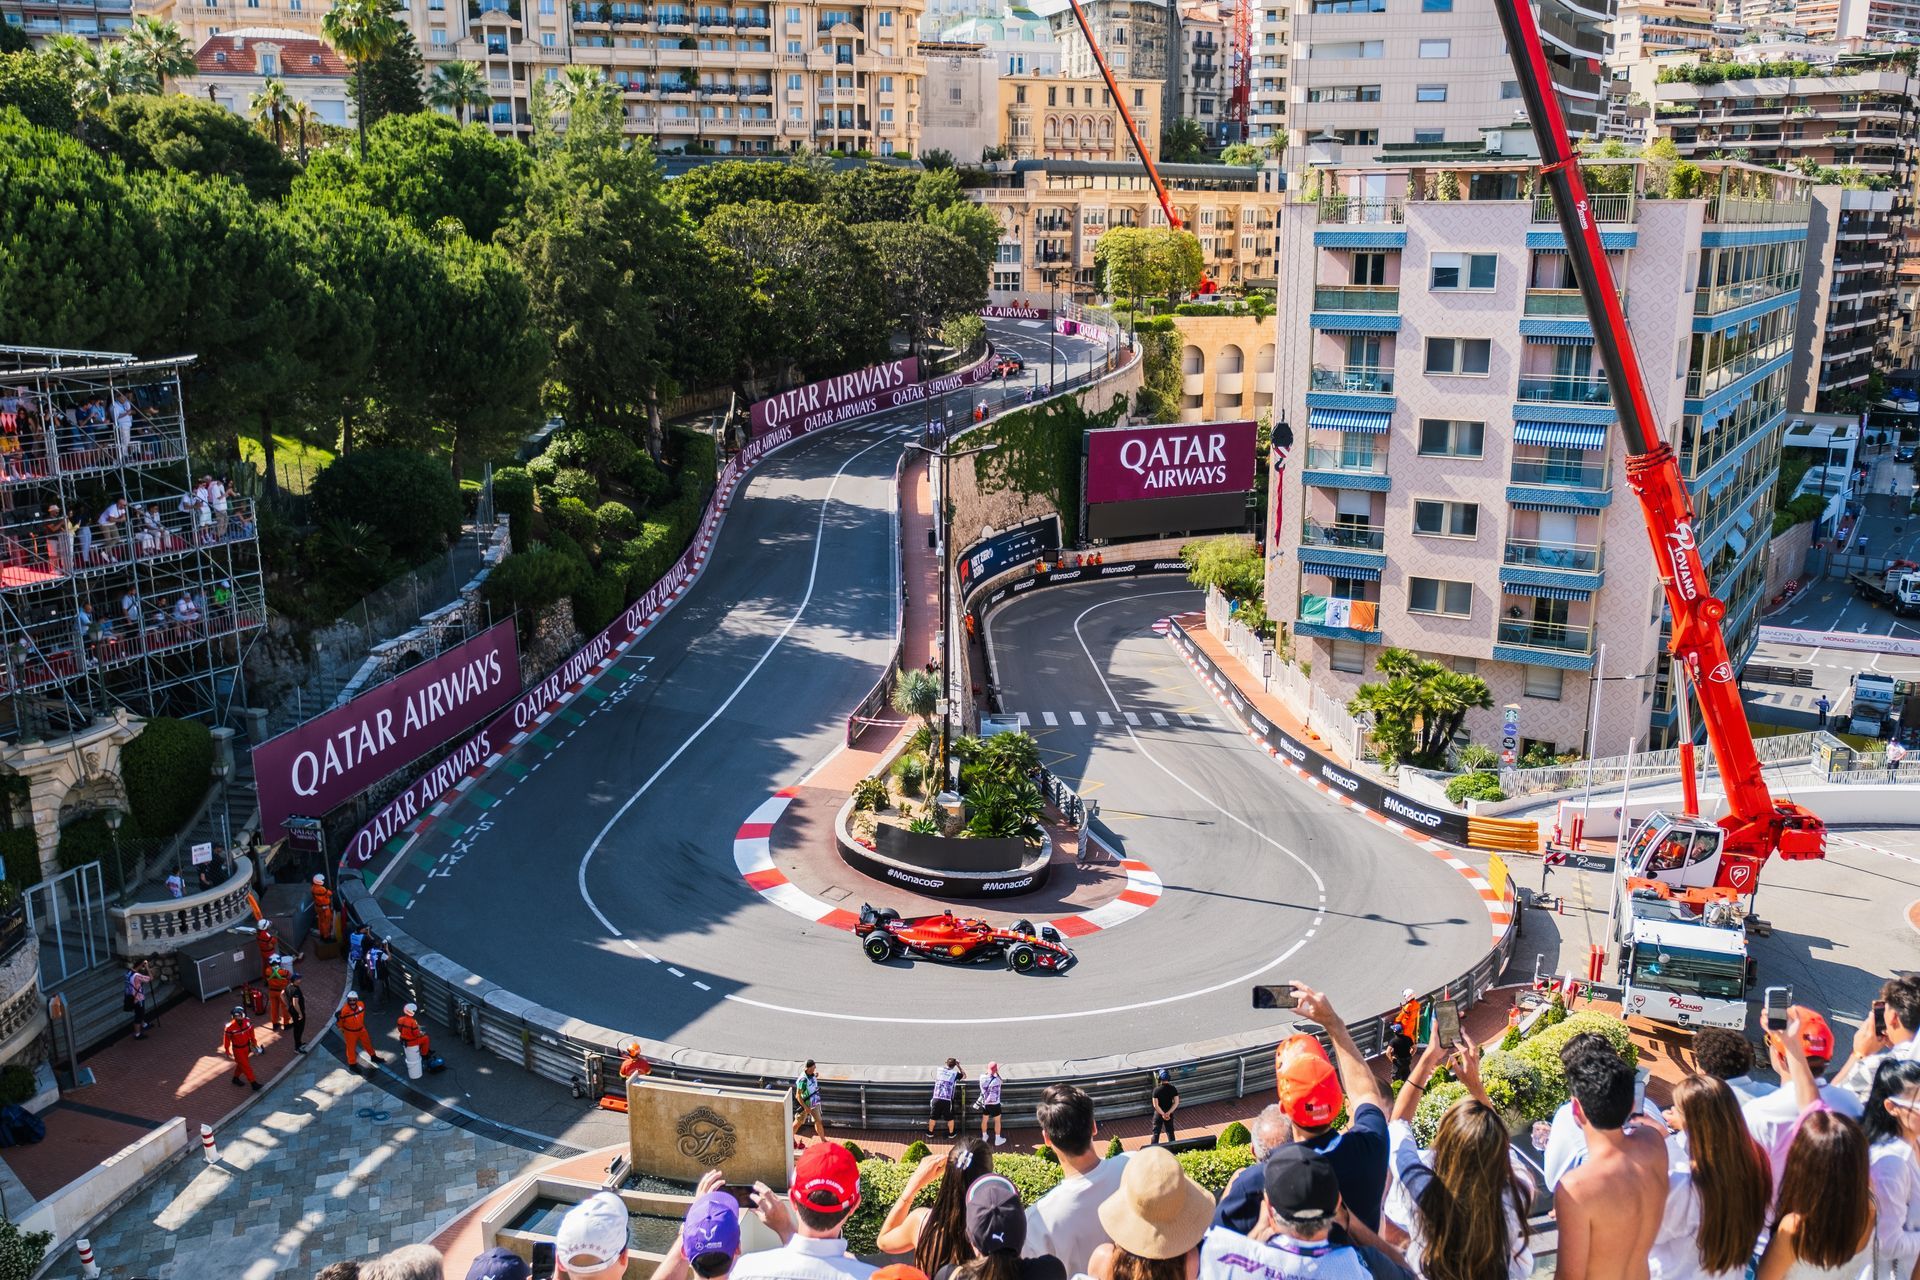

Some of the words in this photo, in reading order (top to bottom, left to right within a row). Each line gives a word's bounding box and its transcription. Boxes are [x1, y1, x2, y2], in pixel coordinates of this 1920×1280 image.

[995, 307, 1040, 318] AIRWAYS
[765, 384, 820, 428] QATAR
[825, 361, 904, 405] AIRWAYS
[892, 385, 925, 405] QATAR
[804, 410, 834, 431] QATAR
[835, 398, 877, 421] AIRWAYS
[741, 440, 762, 465] QATAR
[762, 425, 792, 450] AIRWAYS
[1120, 434, 1226, 475] QATAR
[1143, 465, 1227, 489] AIRWAYS
[1050, 571, 1081, 581] #MonacoGP
[1101, 565, 1136, 575] #MonacoGP
[1665, 522, 1697, 601] PIOVANO
[626, 589, 657, 631] QATAR
[658, 557, 688, 604] AIRWAYS
[514, 675, 561, 728] QATAR
[563, 631, 611, 690] AIRWAYS
[291, 708, 397, 796] QATAR
[403, 649, 502, 738] AIRWAYS
[1322, 765, 1359, 792] #MonacoGP
[357, 790, 418, 862] QATAR
[421, 731, 490, 807] AIRWAYS
[1384, 796, 1442, 827] #MonacoGP
[436, 822, 495, 877] TAXIS
[1576, 856, 1606, 869] PIOVANO
[887, 868, 944, 888] #MonacoGP
[982, 876, 1033, 891] #MonacoGP
[1669, 996, 1703, 1012] PIOVANO
